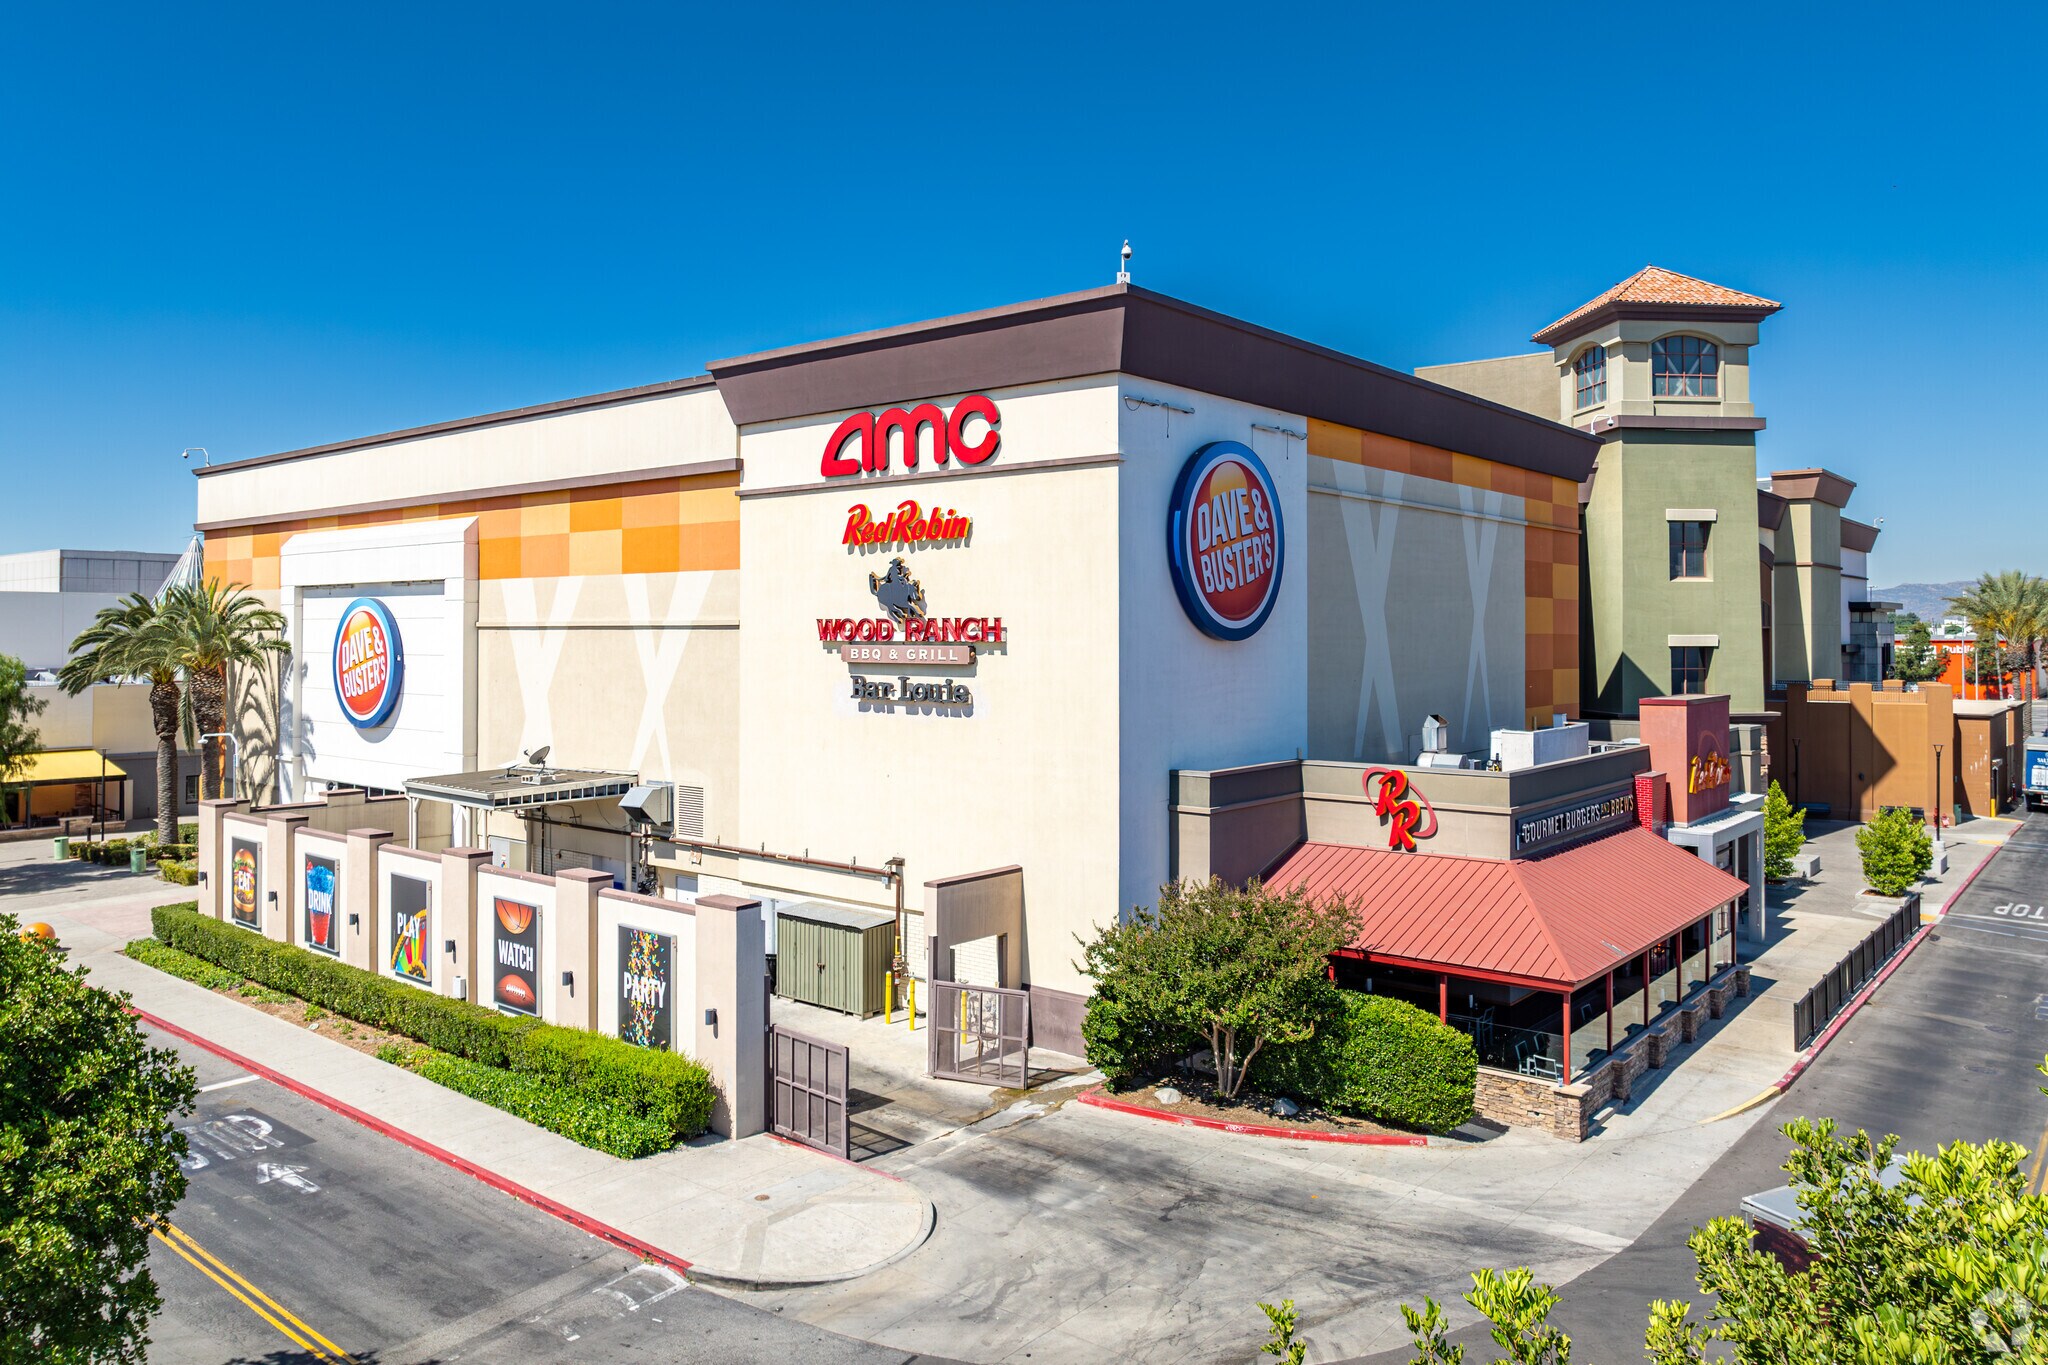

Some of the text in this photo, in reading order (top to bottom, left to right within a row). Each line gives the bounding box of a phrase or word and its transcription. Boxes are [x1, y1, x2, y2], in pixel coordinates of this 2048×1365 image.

[842, 500, 970, 546] Red Robin
[1198, 488, 1270, 552] DAVE &
[1200, 532, 1272, 593] BUSTER'S
[816, 617, 1002, 642] WOOD RANCH
[342, 626, 384, 672] DAVE &
[850, 649, 959, 661] BBQ & GRILL
[343, 655, 386, 698] BUSTER'S
[850, 675, 972, 705] Bar Louie
[1522, 813, 1564, 844] GOURMET
[1565, 804, 1600, 831] BURGERS
[1610, 794, 1634, 817] BREWS
[238, 871, 250, 891] EAT
[308, 889, 332, 915] DRINK
[397, 912, 421, 939] PLAY
[498, 939, 534, 972] WATCH
[623, 971, 666, 1008] PARTY
